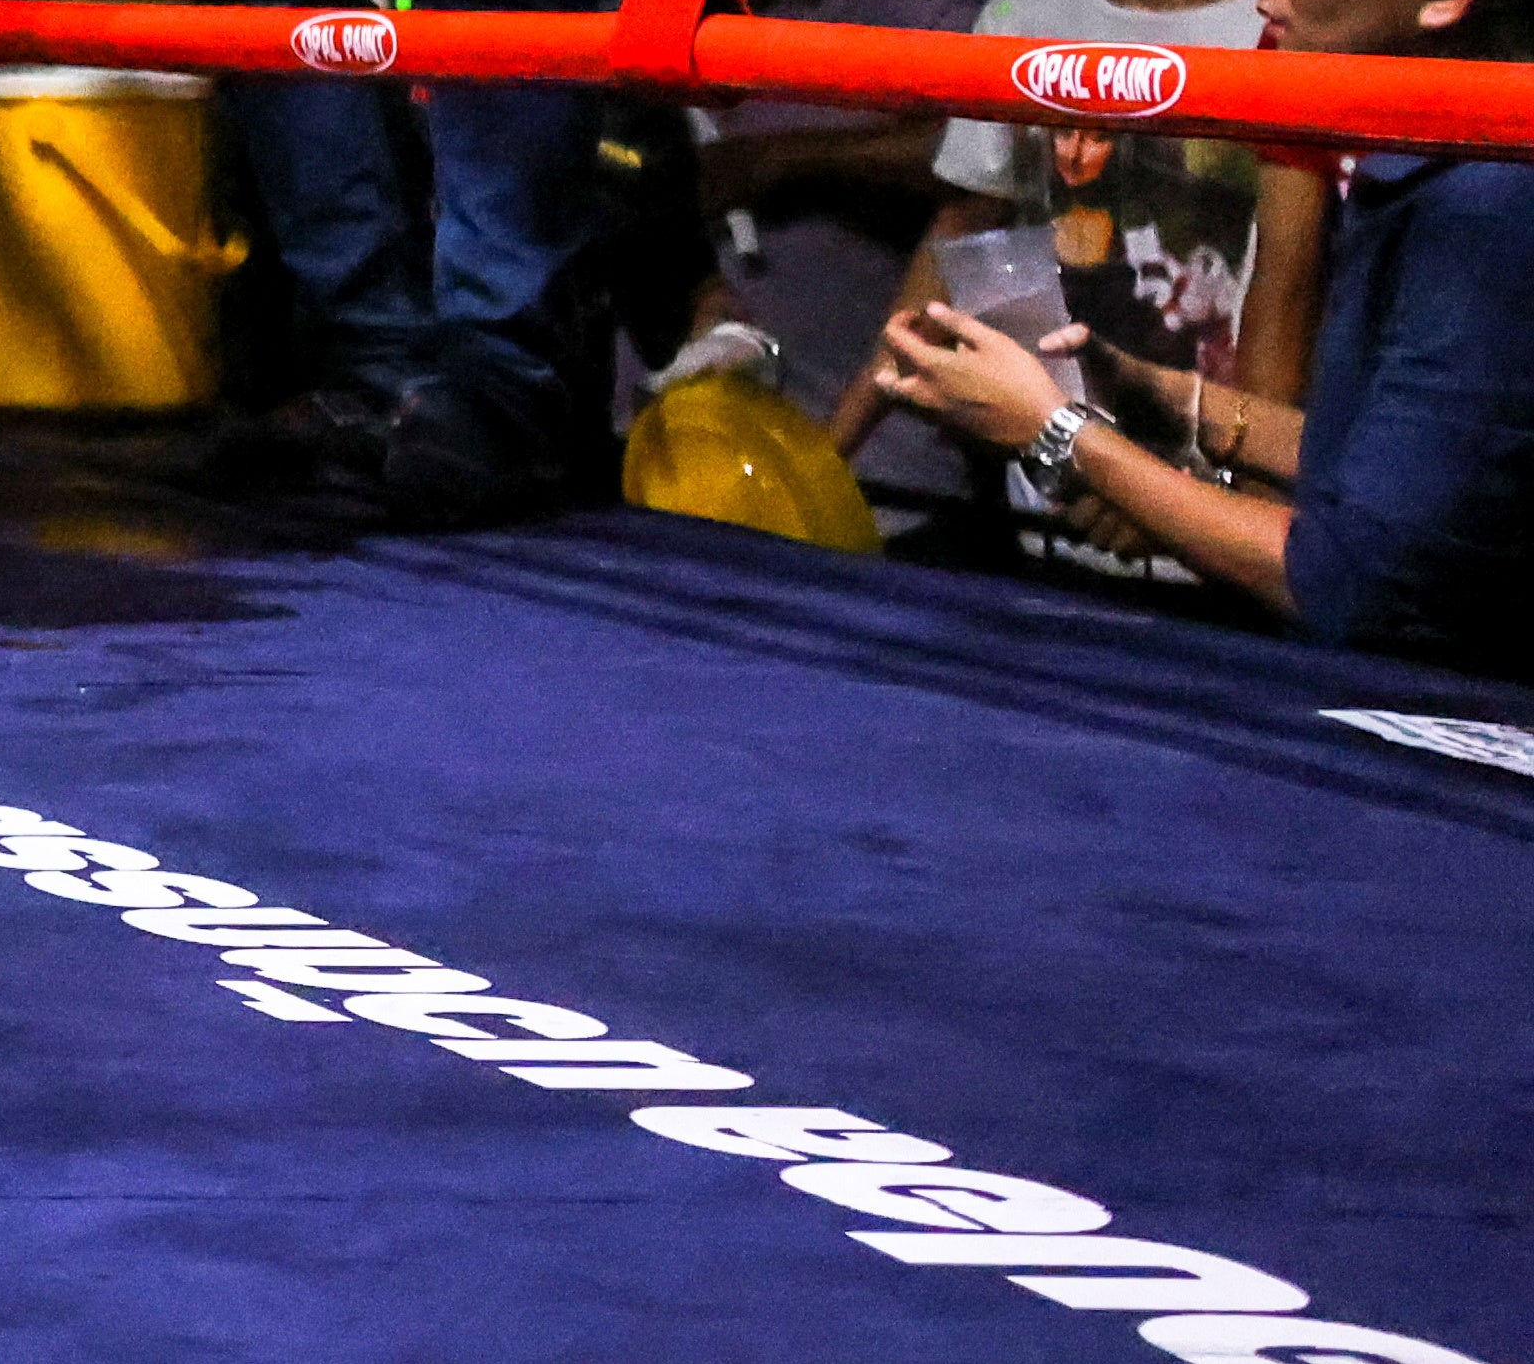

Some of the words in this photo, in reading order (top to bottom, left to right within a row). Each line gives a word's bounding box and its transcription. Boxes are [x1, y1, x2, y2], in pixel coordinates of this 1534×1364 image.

[300, 25, 343, 63] OPAL
[343, 24, 389, 64] PAINT
[1028, 51, 1092, 100] OPAL
[1097, 55, 1172, 102] PAINT
